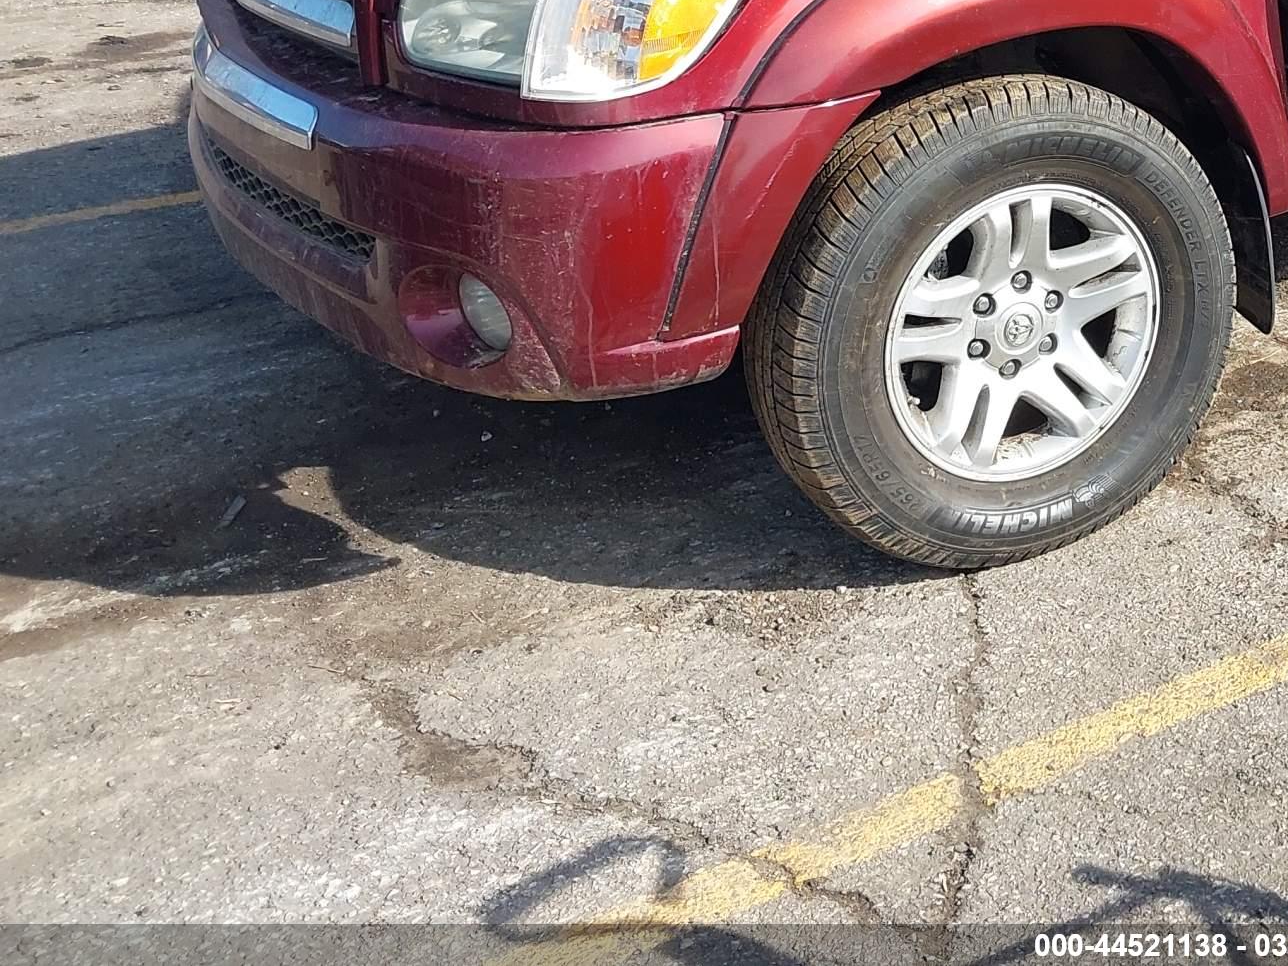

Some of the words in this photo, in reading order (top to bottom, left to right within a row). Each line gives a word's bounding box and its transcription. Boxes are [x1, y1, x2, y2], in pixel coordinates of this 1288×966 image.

[1006, 136, 1144, 174] MICHELIN
[1143, 164, 1202, 252] DEFENDER
[946, 497, 1075, 535] MICHELIN
